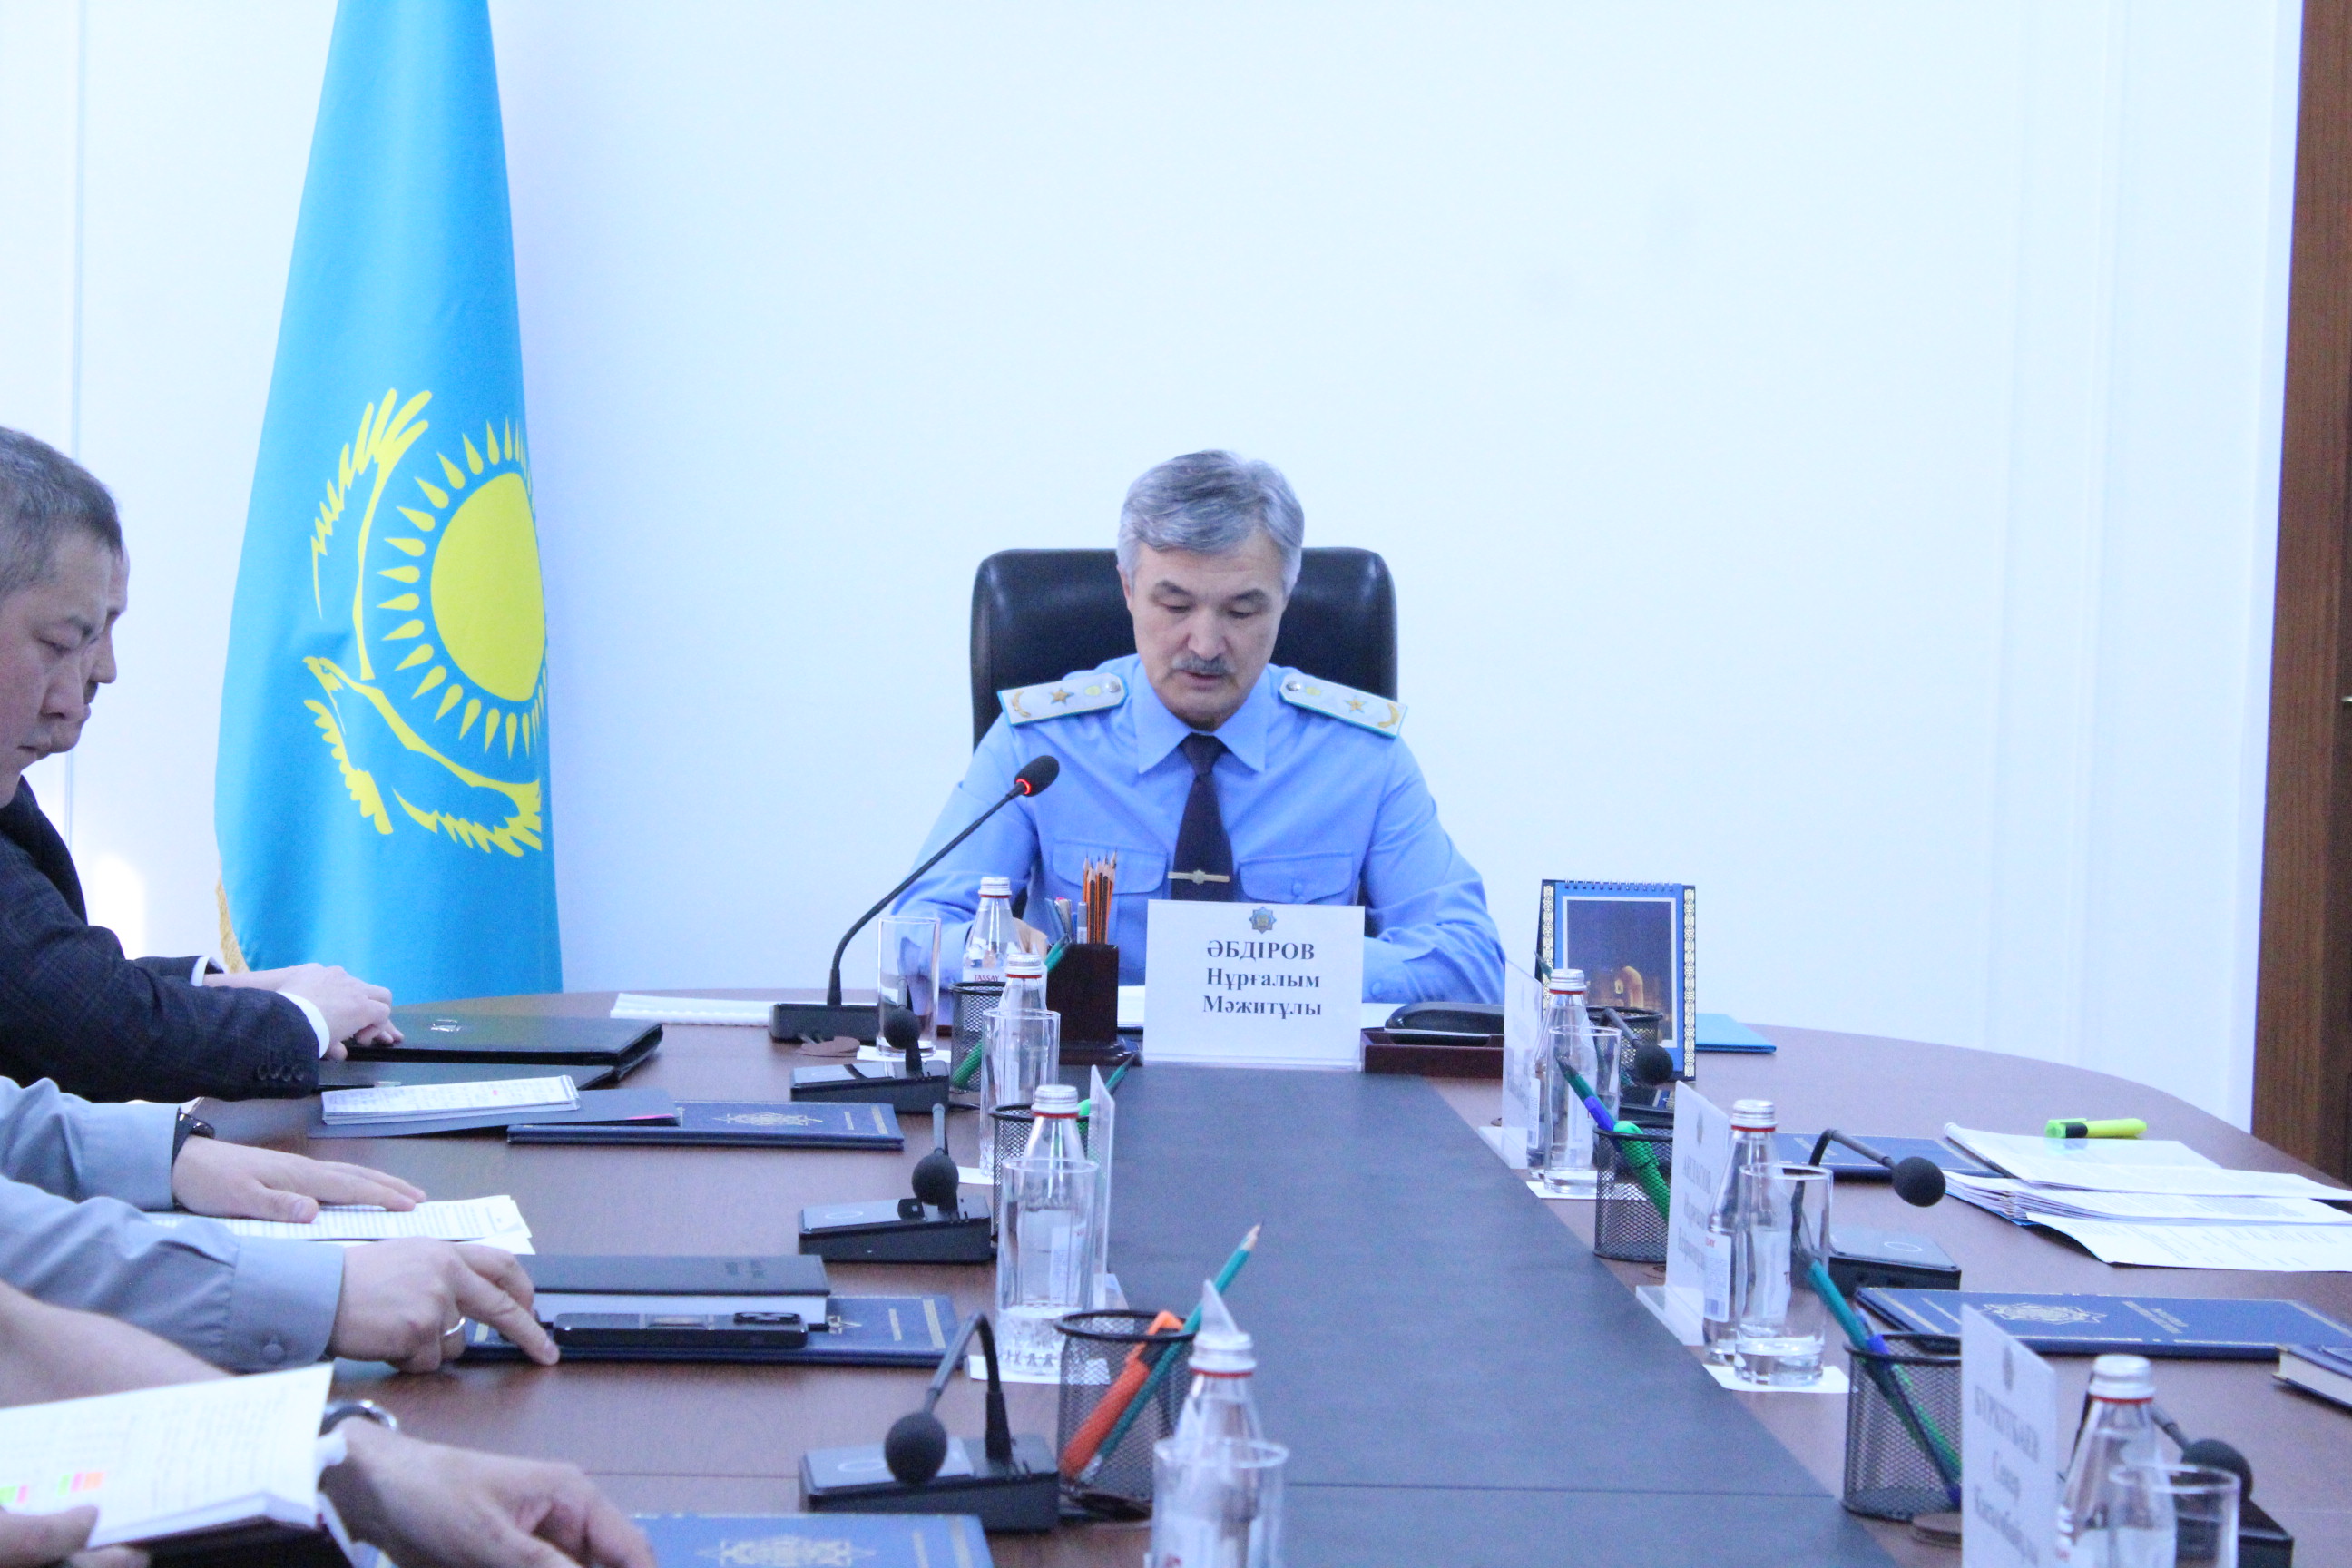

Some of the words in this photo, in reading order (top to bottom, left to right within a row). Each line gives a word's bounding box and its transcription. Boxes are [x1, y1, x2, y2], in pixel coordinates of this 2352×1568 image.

[1207, 940, 1315, 963] ӘБДІРОВ
[1206, 968, 1320, 991] Нұрғалым
[1203, 995, 1322, 1020] Мәжитұлы
